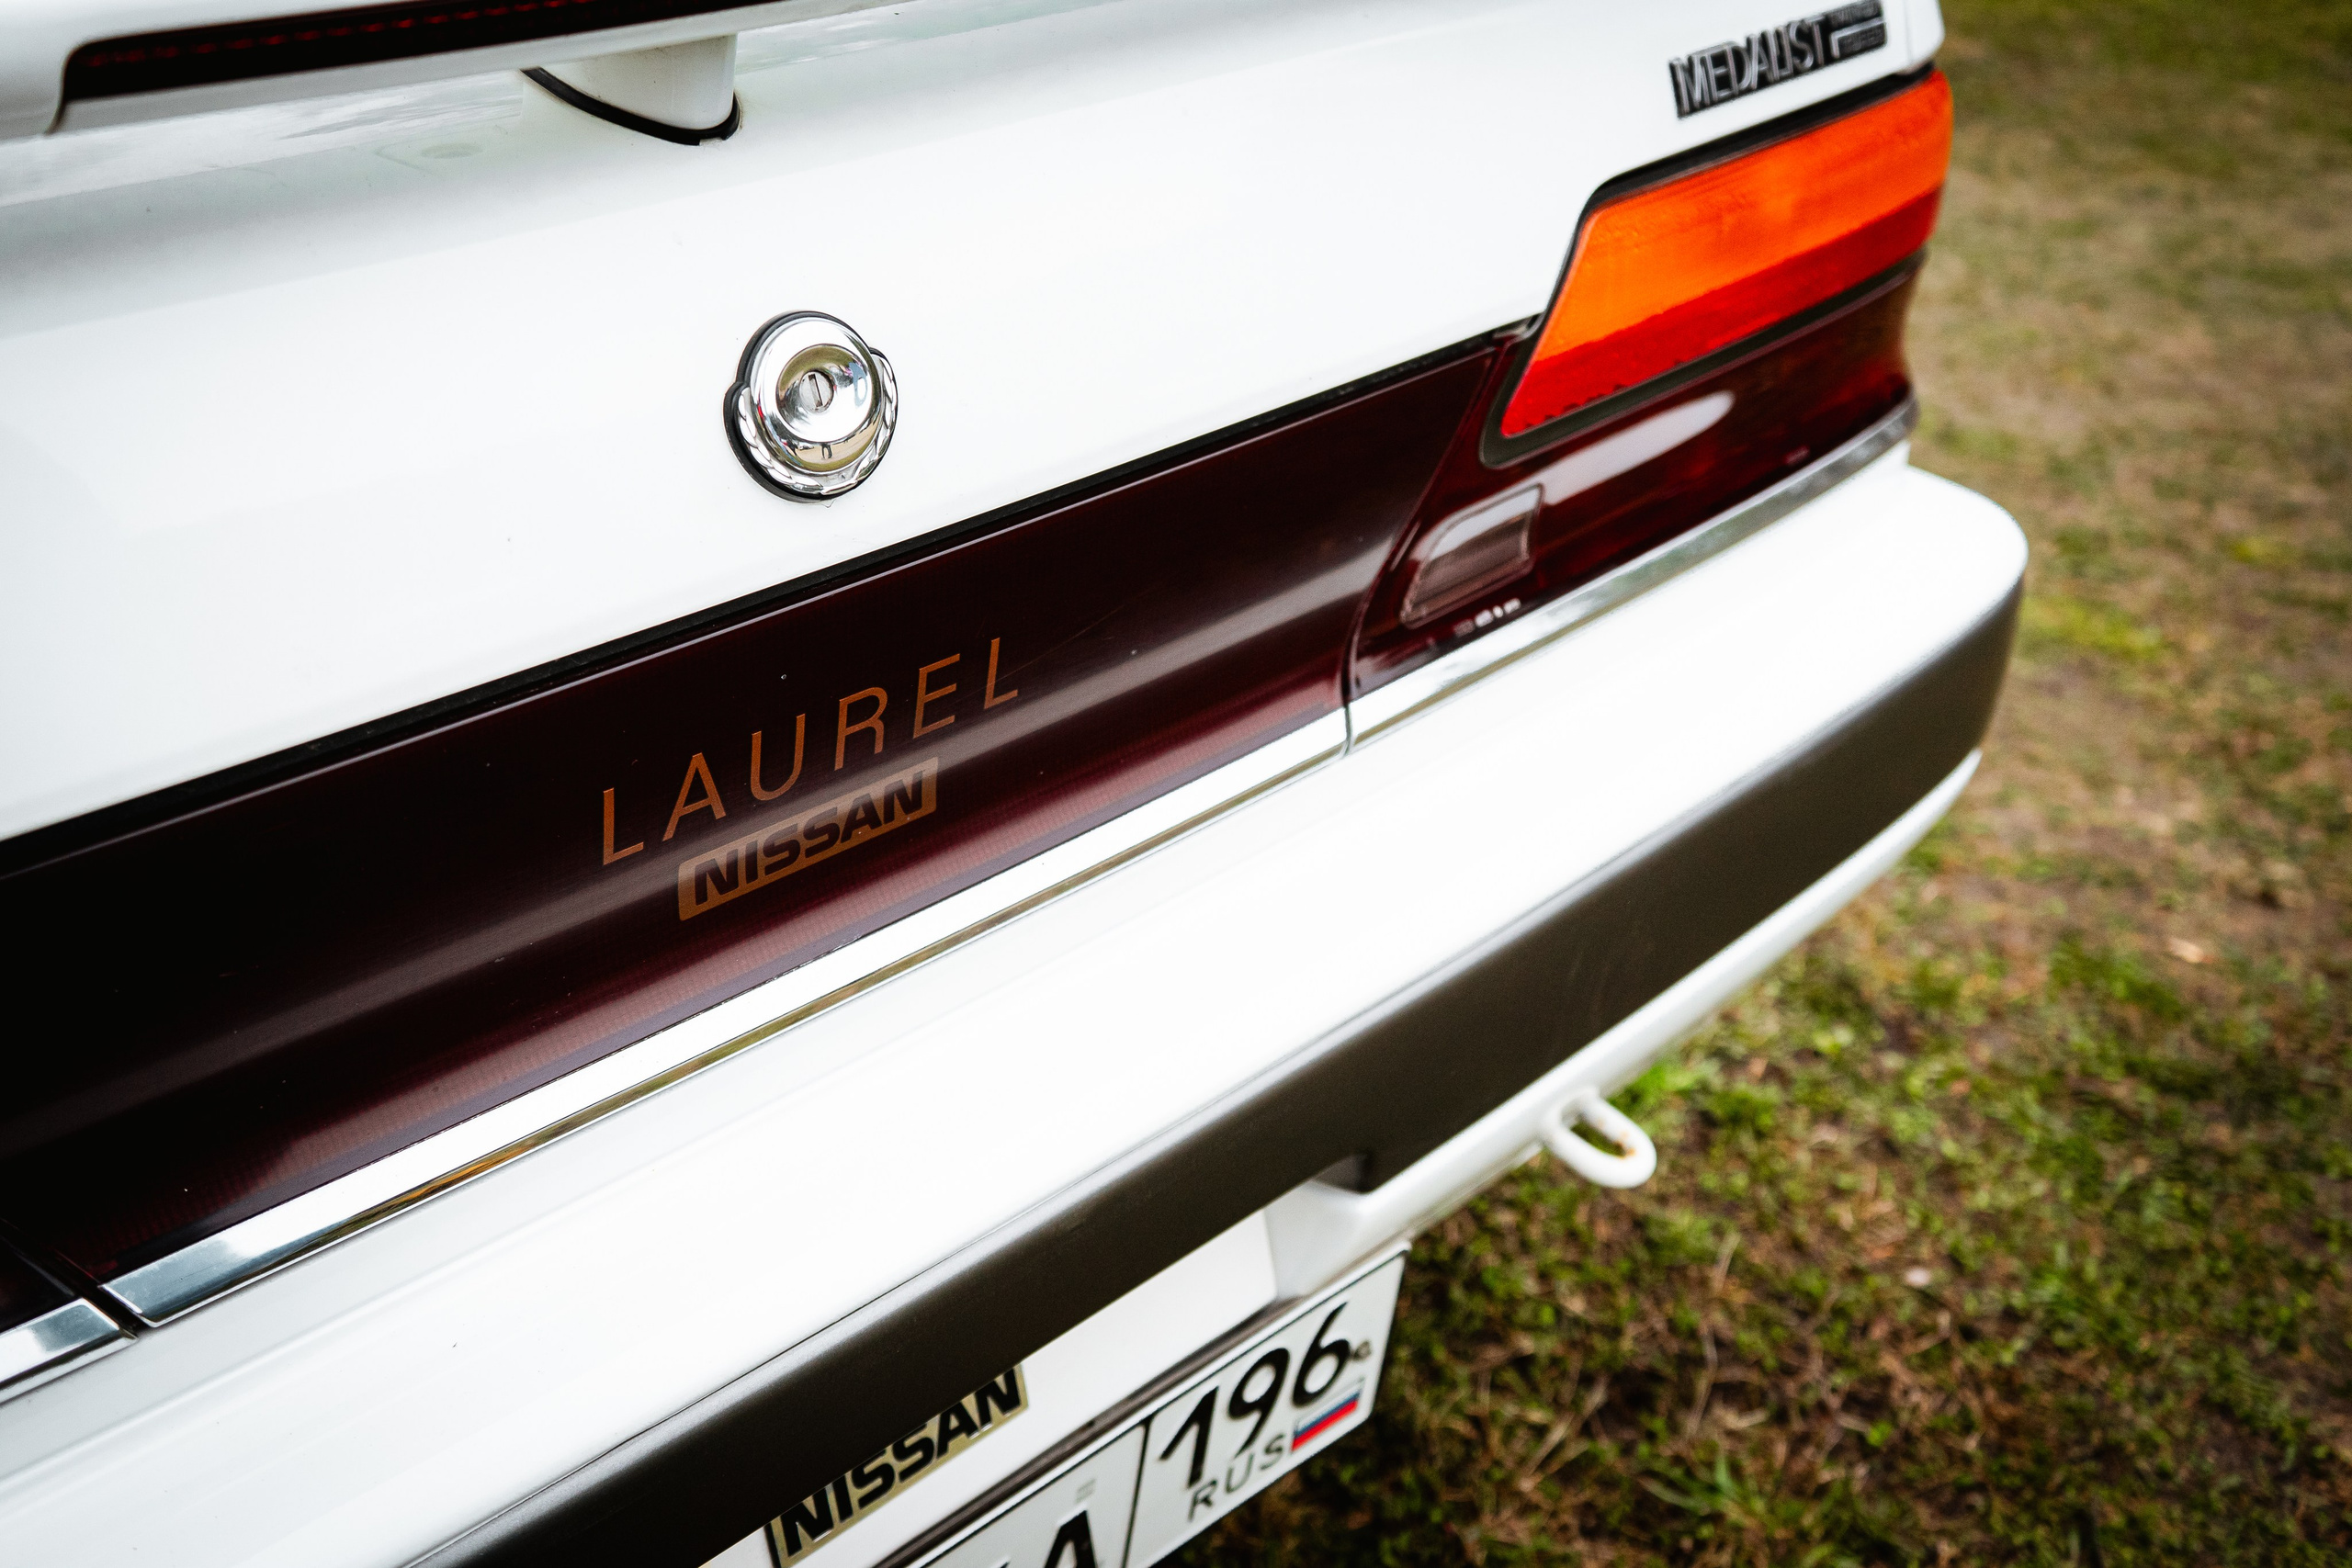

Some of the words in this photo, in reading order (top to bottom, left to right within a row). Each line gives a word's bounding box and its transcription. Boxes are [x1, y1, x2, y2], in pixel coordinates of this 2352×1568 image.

[1668, 16, 1825, 117] MEDALIST
[602, 637, 1018, 865] LAUREL
[695, 771, 924, 906] NISSAN
[781, 1368, 1022, 1557] NISSAN
[1159, 1301, 1348, 1489] 196
[1188, 1433, 1285, 1522] RUS
